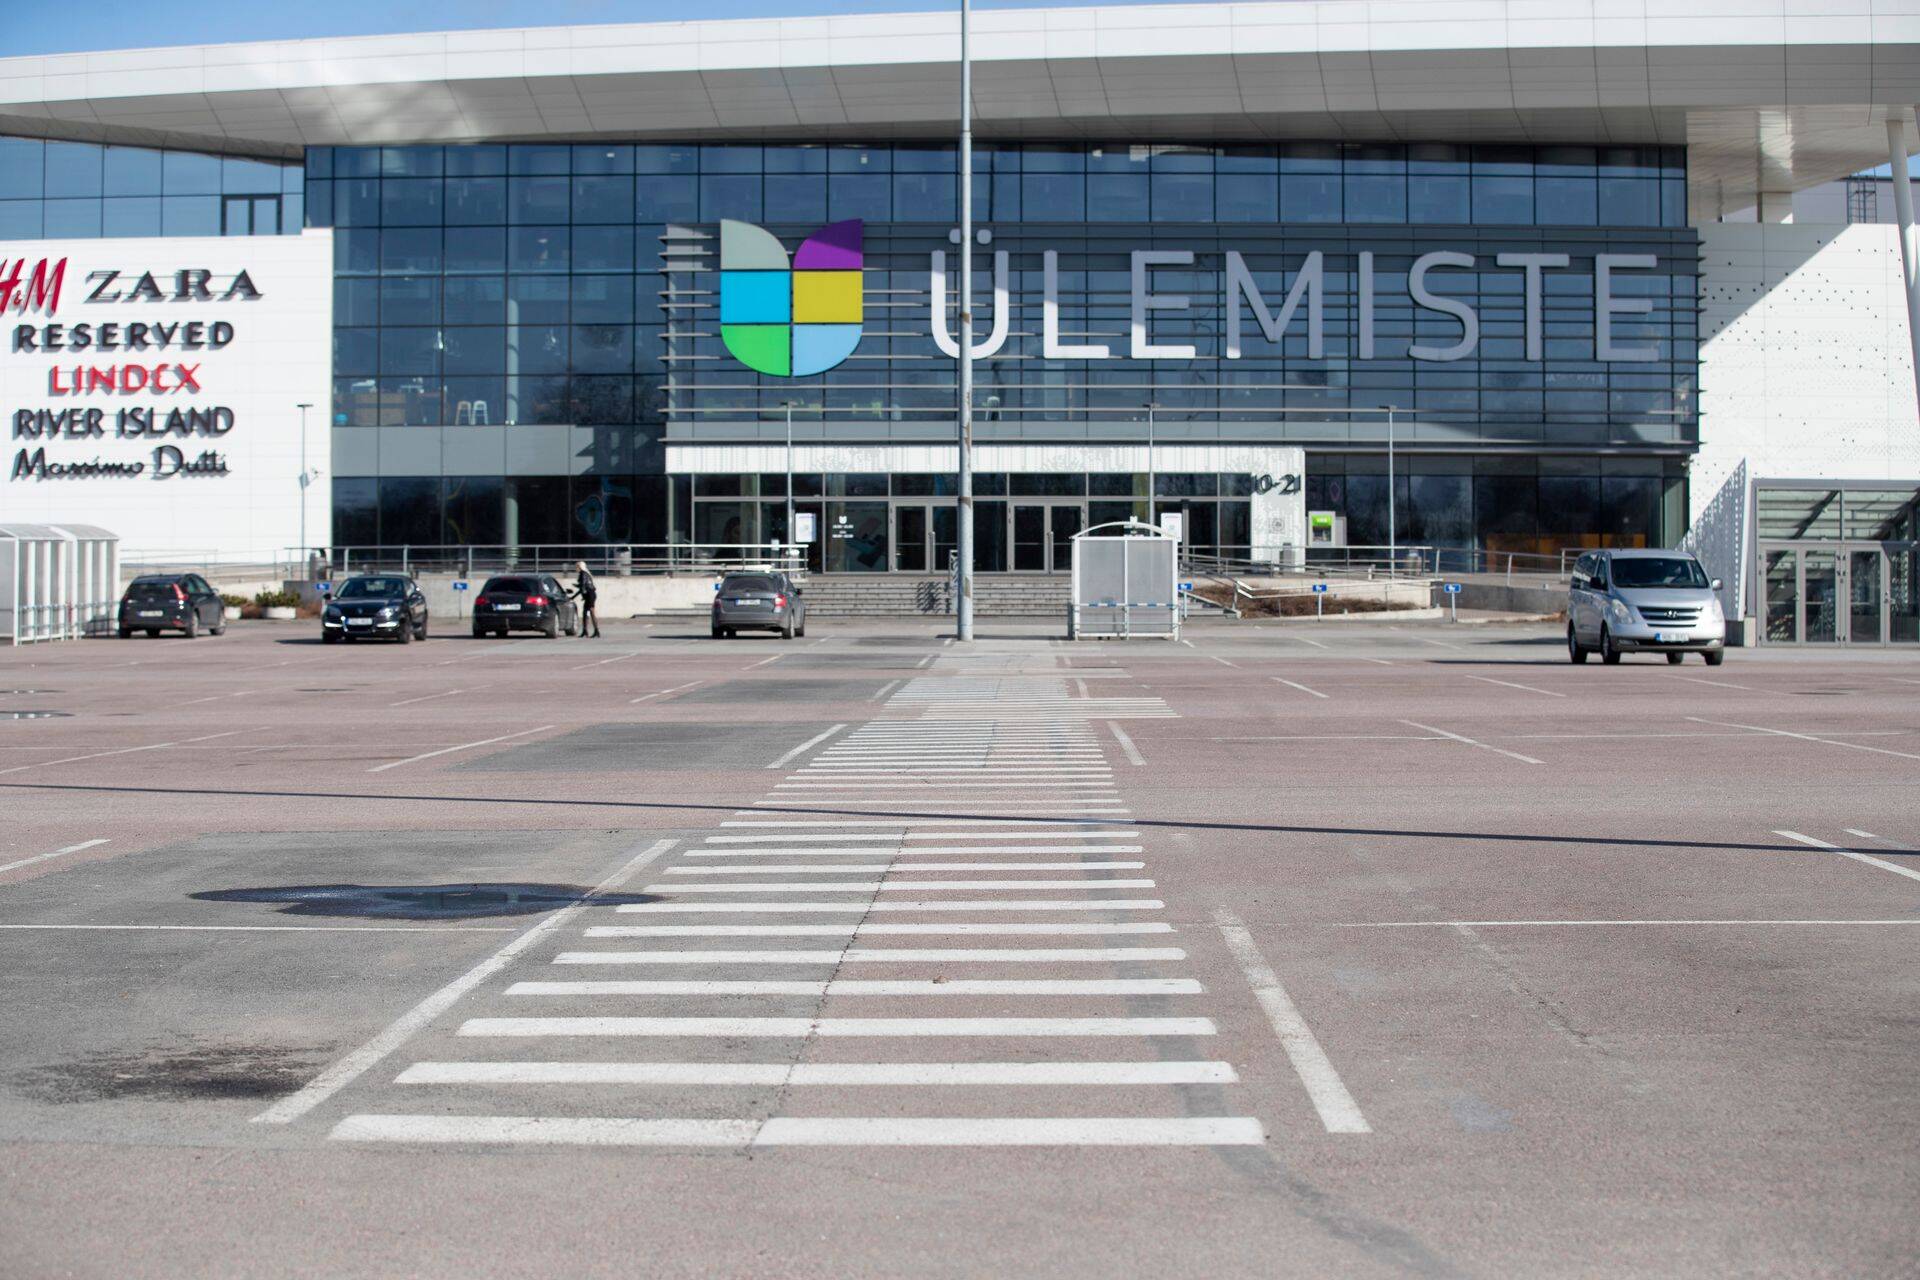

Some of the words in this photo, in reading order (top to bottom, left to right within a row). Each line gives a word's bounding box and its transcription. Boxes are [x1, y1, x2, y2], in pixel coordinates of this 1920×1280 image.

[86, 269, 262, 302] ZARA
[931, 228, 1660, 361] ÜLEMISTE
[16, 321, 235, 350] RESERVED
[51, 363, 201, 394] LINDEX
[16, 408, 105, 436] RIVER
[118, 406, 235, 435] ISLAND
[14, 446, 145, 478] Massimo
[155, 444, 232, 477] Dutti
